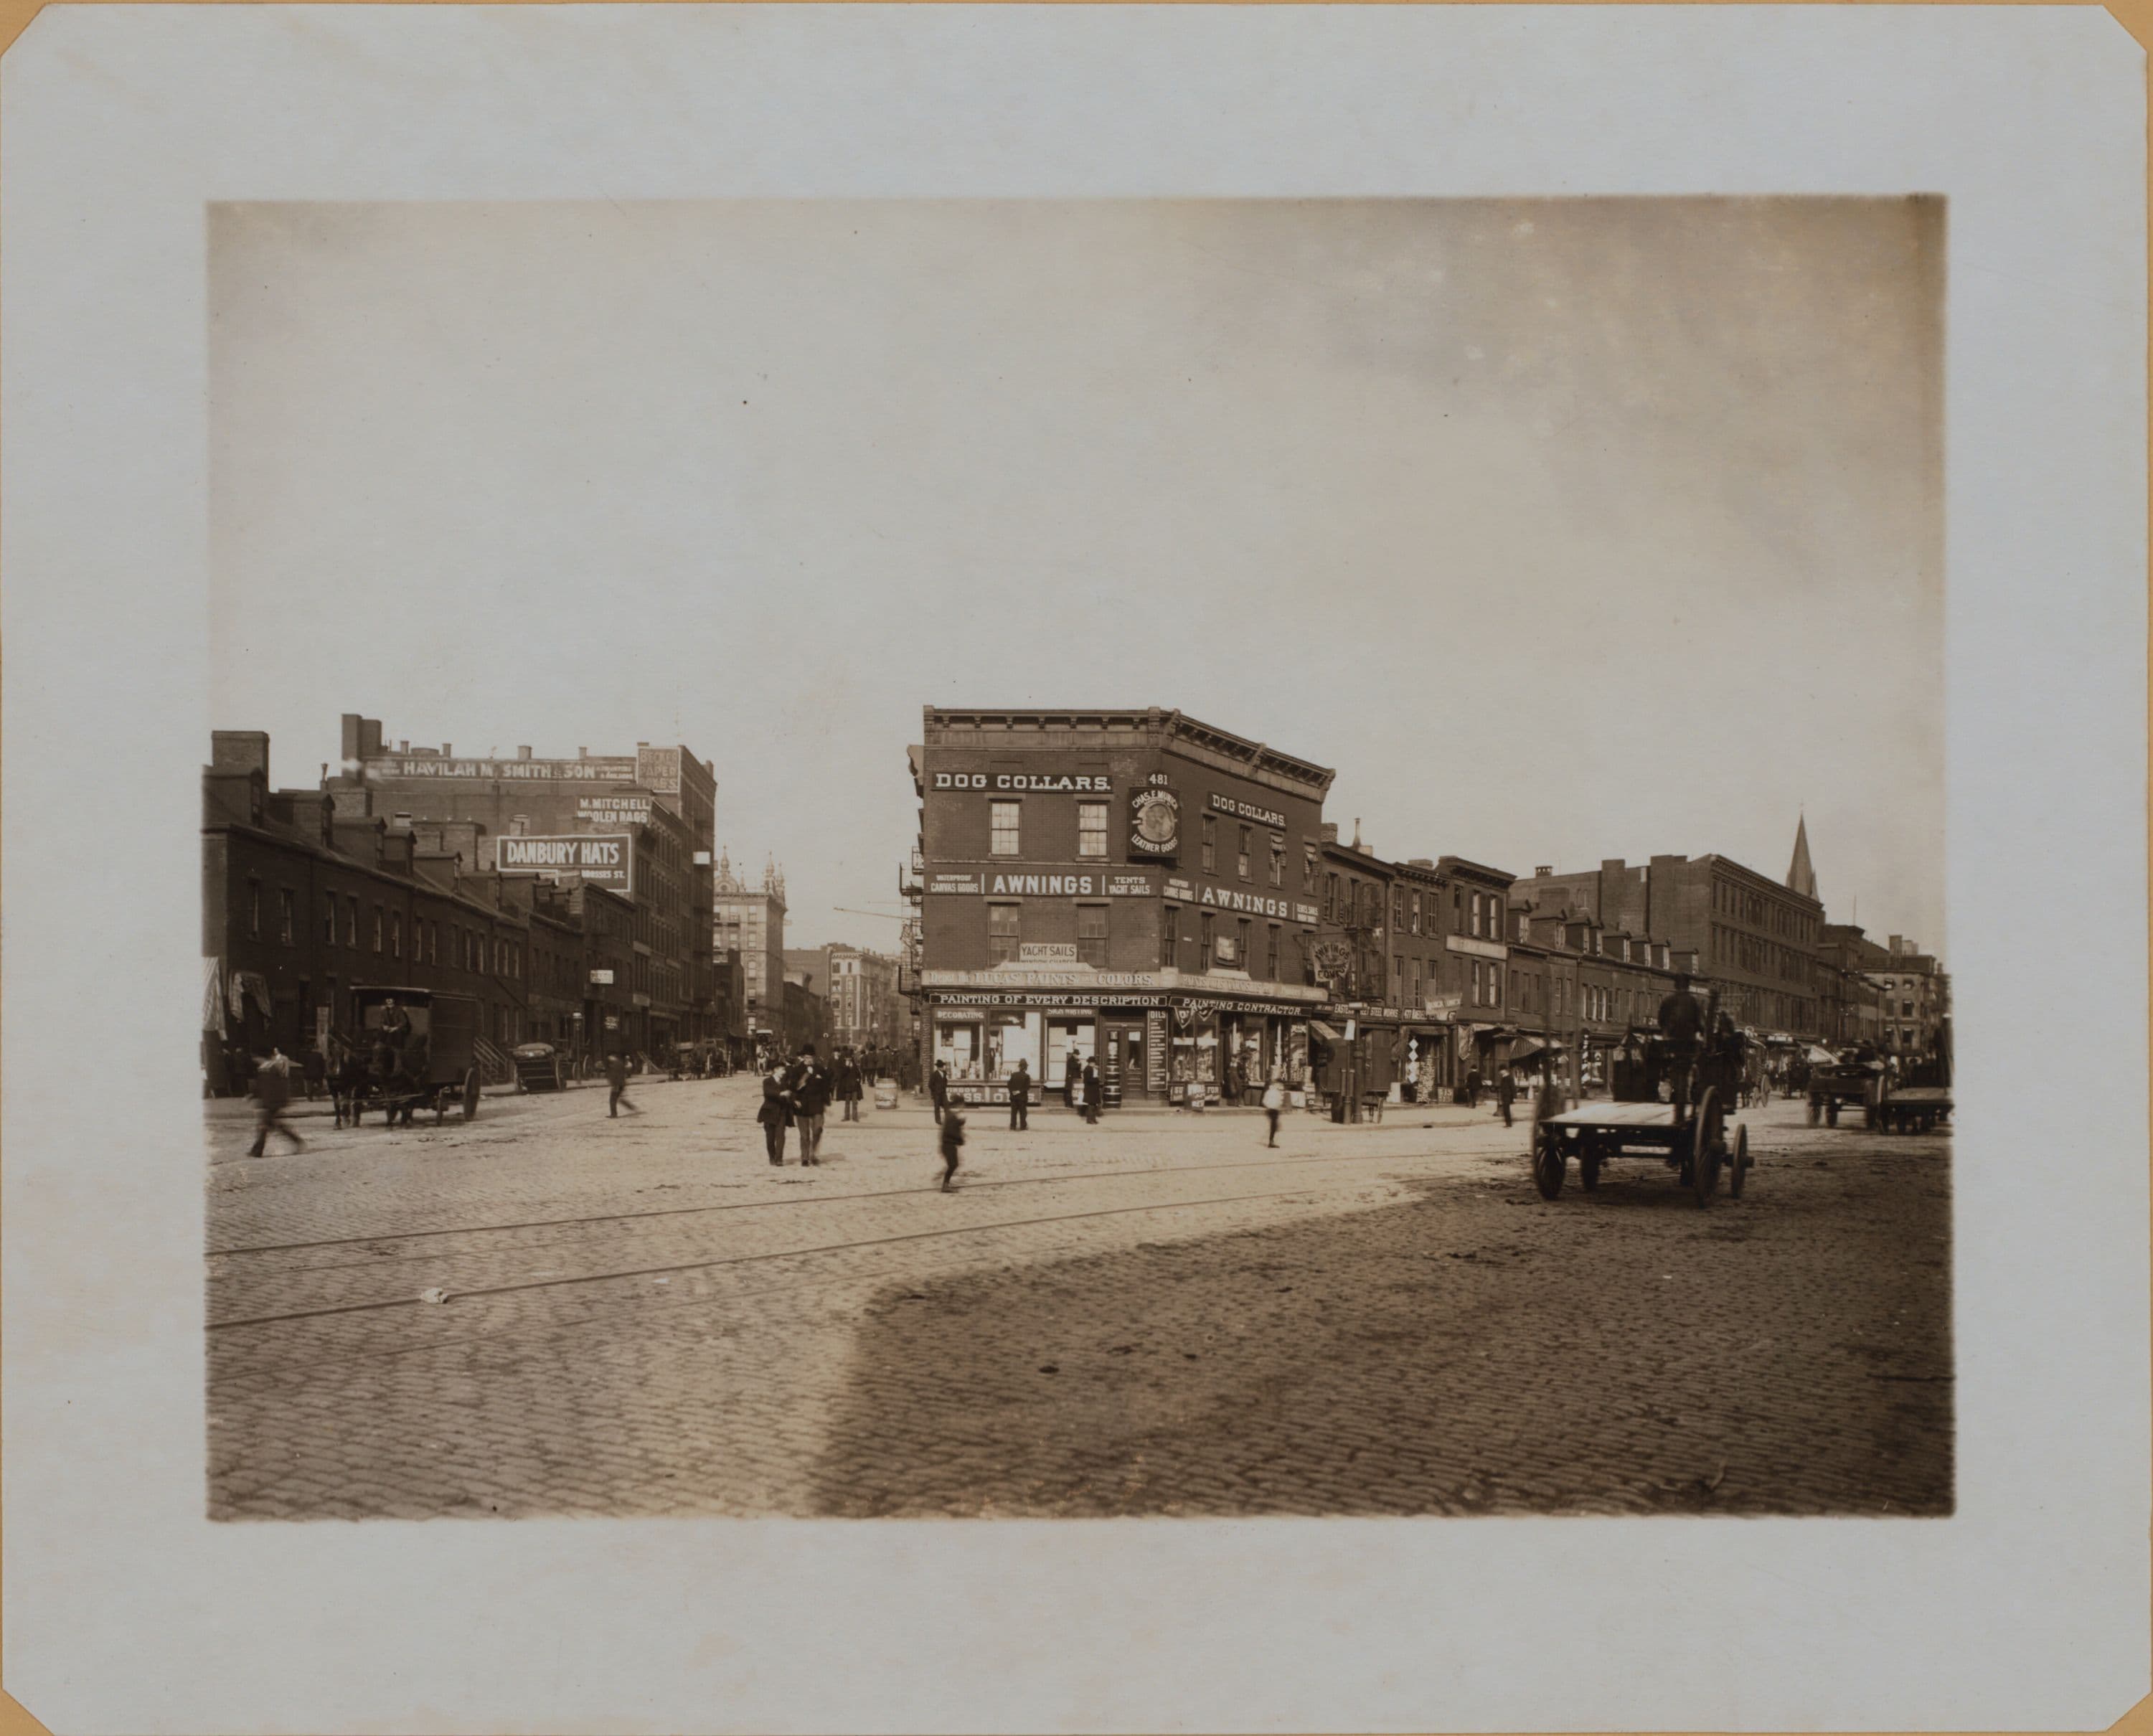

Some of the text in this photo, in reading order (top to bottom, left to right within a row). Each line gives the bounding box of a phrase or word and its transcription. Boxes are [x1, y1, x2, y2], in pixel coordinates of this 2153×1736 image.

[564, 764, 596, 779] SON
[936, 773, 1111, 791] DOG COLLARS.
[1149, 773, 1168, 785] 481
[592, 798, 650, 809] MITCHELL
[1212, 794, 1286, 826] DOG COLLARS.
[578, 811, 647, 823] WOOLEN RAGS
[1131, 834, 1178, 853] LEATHER GOODS
[507, 841, 619, 864] DANBURY HATS
[931, 882, 979, 892] CANVAS GOODS
[992, 874, 1093, 895] AWNINGS
[1108, 884, 1151, 895] YACHT SAILS
[1202, 887, 1287, 917] AWNINGS
[1022, 945, 1075, 956] YACHT SAILS
[1027, 973, 1076, 986] PAINTS
[941, 995, 1159, 1005] PAINTING OF EVERY DESCRIPTION
[1182, 998, 1234, 1010] PAINTING
